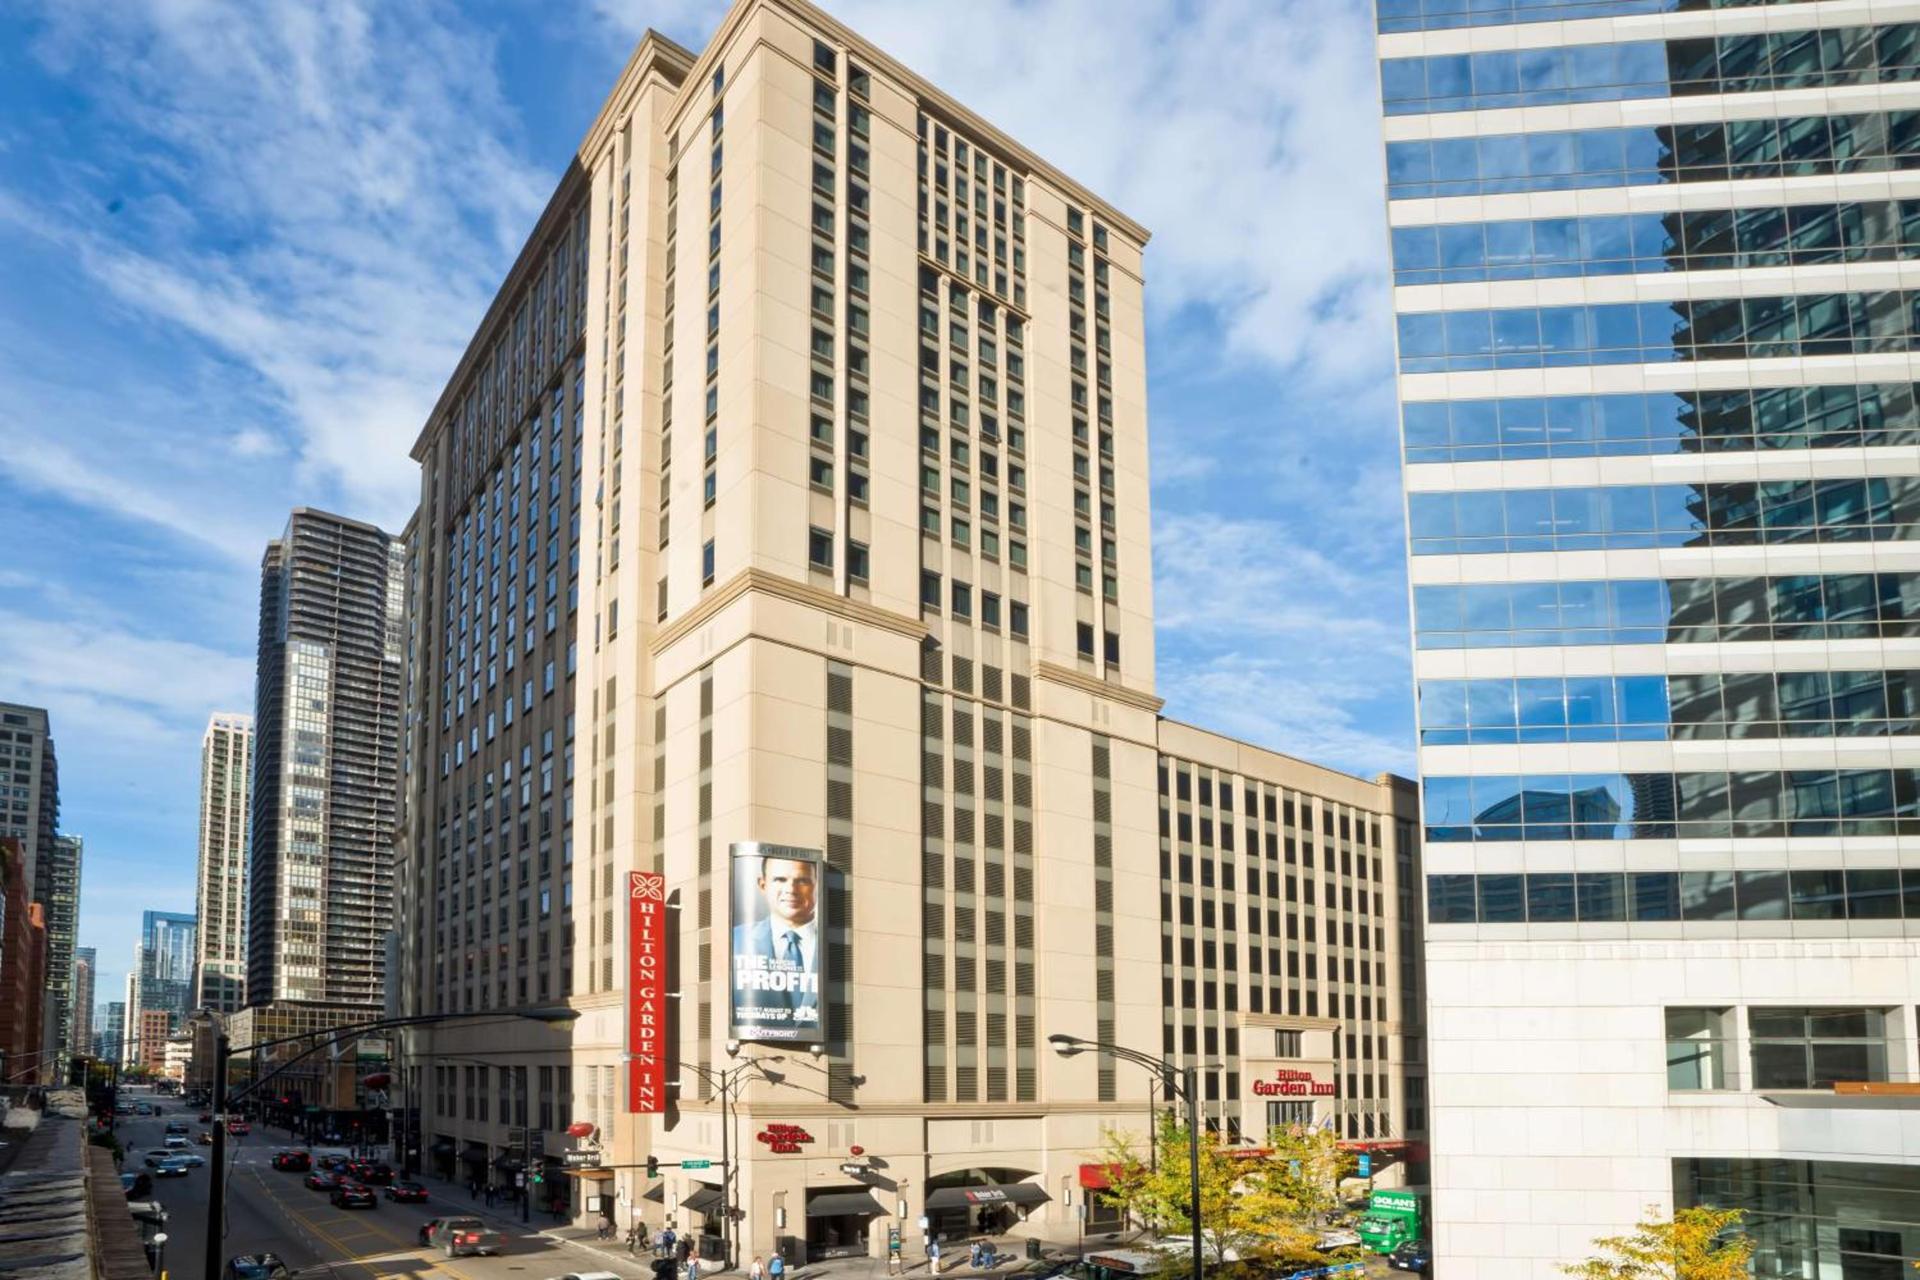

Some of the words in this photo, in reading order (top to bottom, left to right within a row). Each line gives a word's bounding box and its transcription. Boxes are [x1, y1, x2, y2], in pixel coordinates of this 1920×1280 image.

[640, 902, 656, 980] HILTON
[735, 955, 769, 970] THE
[640, 987, 656, 1066] GARDEN
[1254, 1080, 1306, 1095] Garden
[1310, 1081, 1334, 1095] Inn
[1277, 1069, 1312, 1081] Hilton
[640, 1073, 656, 1112] INN
